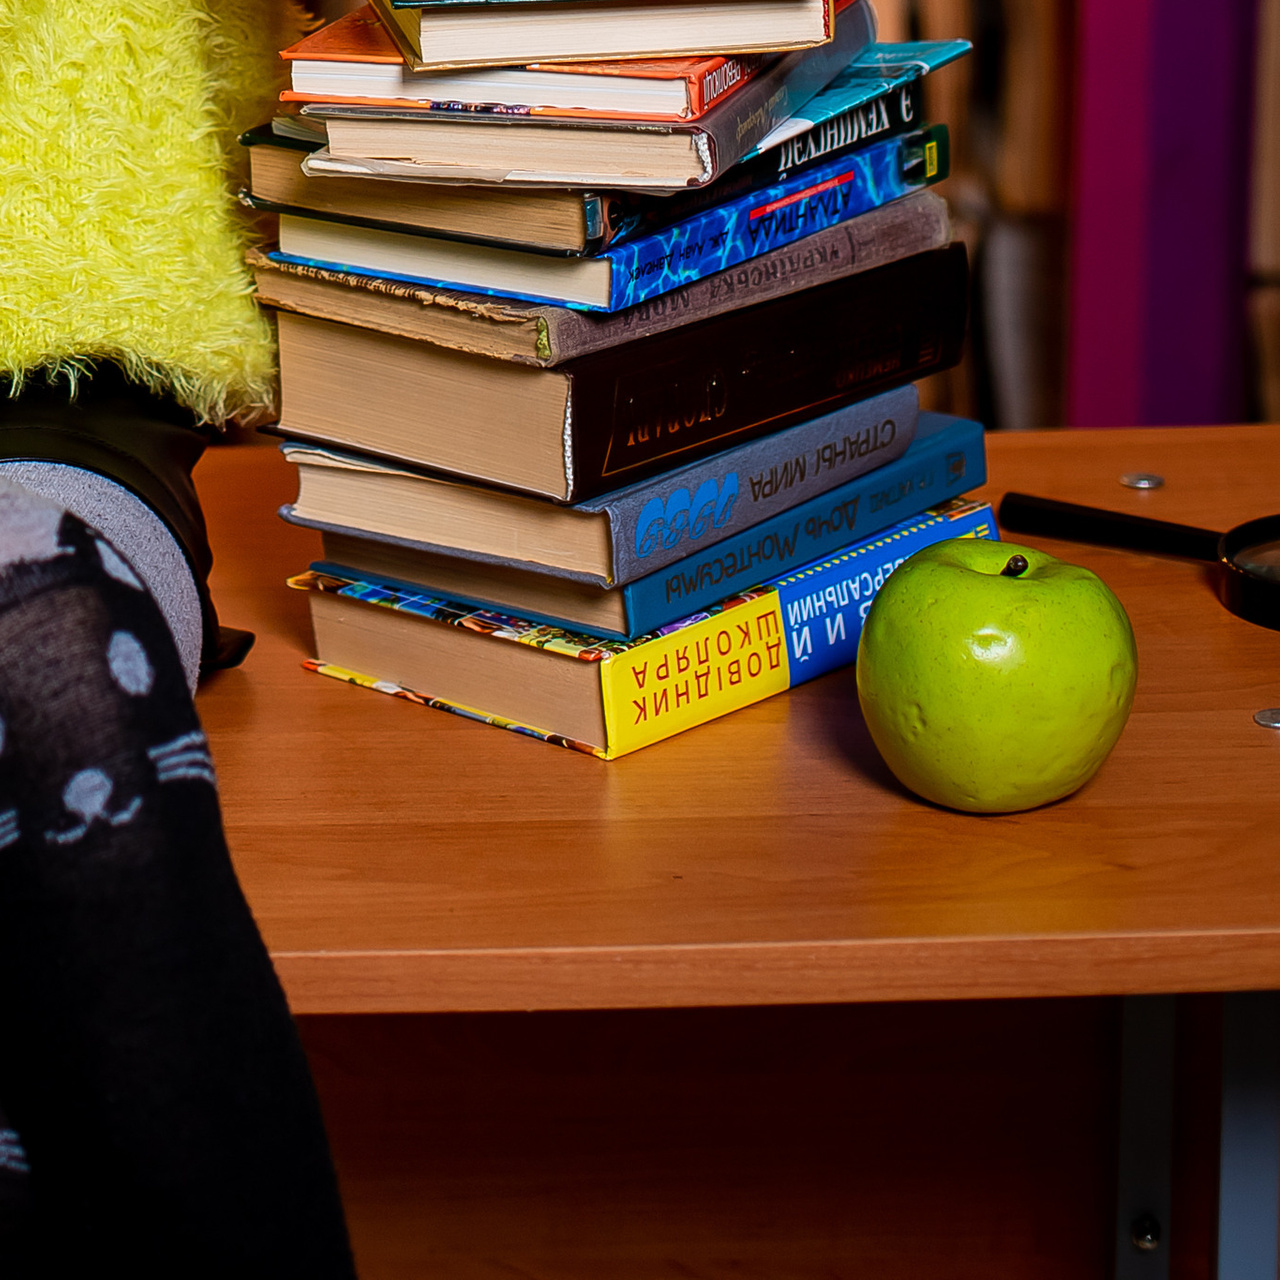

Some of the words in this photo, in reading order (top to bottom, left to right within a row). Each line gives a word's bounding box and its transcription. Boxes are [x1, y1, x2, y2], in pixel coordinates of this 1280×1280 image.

[749, 182, 853, 244] АТЛАНТИДА
[678, 243, 703, 262] Алан
[748, 454, 806, 502] МИРА
[813, 419, 897, 477] СТРАНЫ
[635, 472, 739, 558] 1989
[805, 494, 861, 539] Дочь
[666, 517, 800, 604] Монтесумы
[787, 553, 911, 630] ЕРСАЛЬНИЙ
[631, 609, 780, 689] ШКОЛЯРА
[632, 637, 781, 725] ДОВІДНИК
